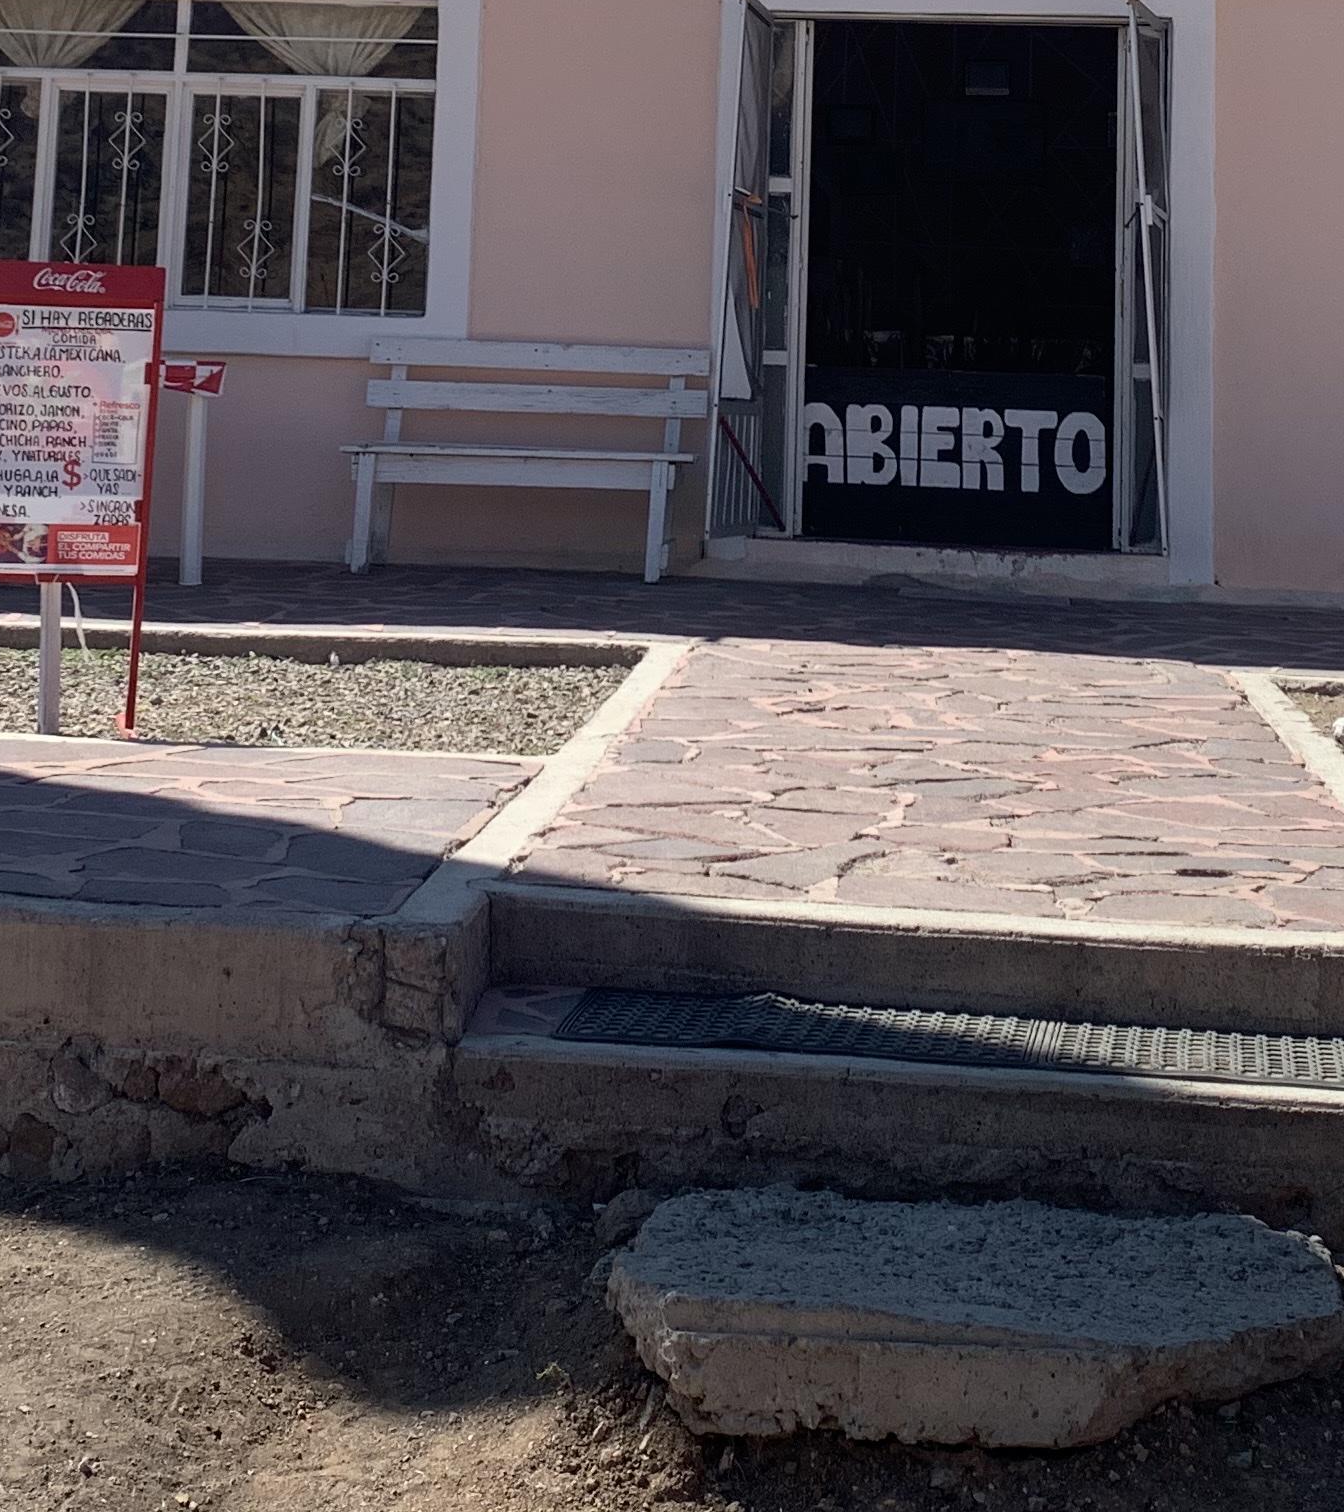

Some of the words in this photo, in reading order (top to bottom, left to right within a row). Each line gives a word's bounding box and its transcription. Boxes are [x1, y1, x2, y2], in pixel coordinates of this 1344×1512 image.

[22, 310, 35, 326] SI
[41, 310, 71, 326] HAY
[78, 311, 153, 329] REGADERAS
[52, 333, 97, 345] COMIDA
[802, 402, 1107, 495] ABIERTO
[58, 533, 107, 541] DISFRUTA
[72, 543, 131, 552] COMPARTIR
[58, 551, 77, 559] TUS
[78, 551, 126, 560] COMIDAS
